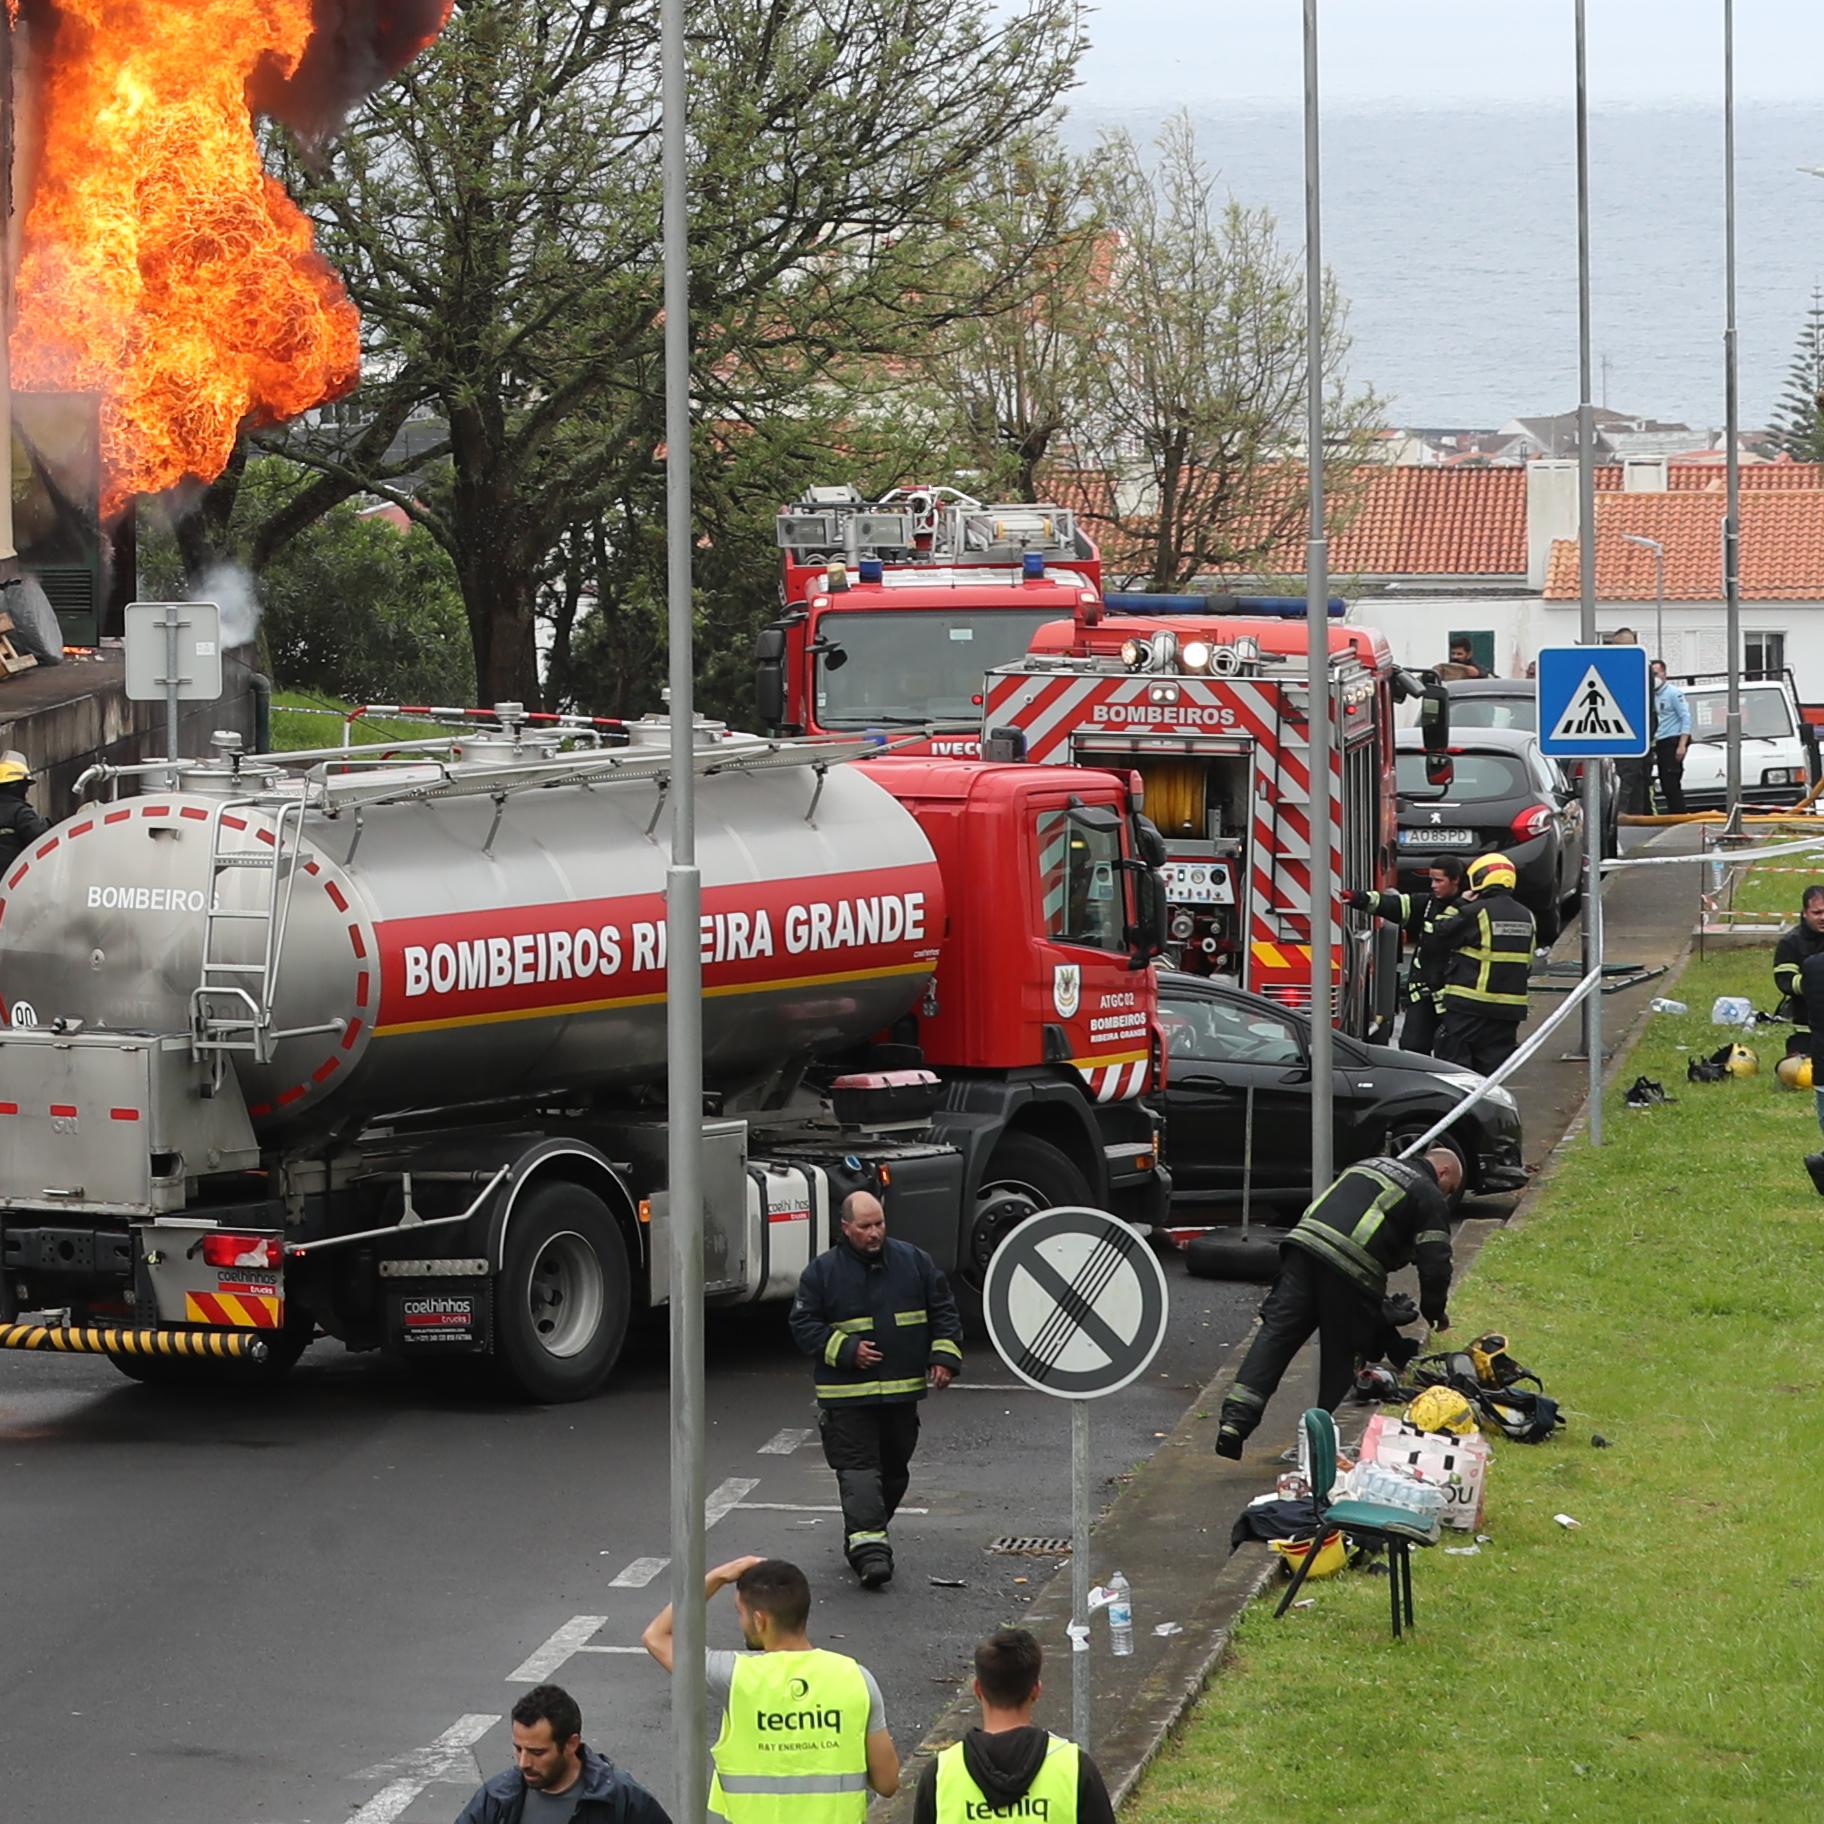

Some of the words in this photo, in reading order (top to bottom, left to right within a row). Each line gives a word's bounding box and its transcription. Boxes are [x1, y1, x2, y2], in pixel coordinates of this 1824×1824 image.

[1093, 705, 1235, 725] BOMBEIROS
[404, 925, 622, 997] BOMBEIROS
[631, 910, 773, 972] RIEIRA
[784, 892, 926, 954] GRANDE
[1100, 993, 1124, 1009] ATGC
[1090, 1012, 1146, 1031] BOMBEIROS
[404, 1298, 471, 1314] coelhinhos
[757, 1704, 841, 1734] tecniq
